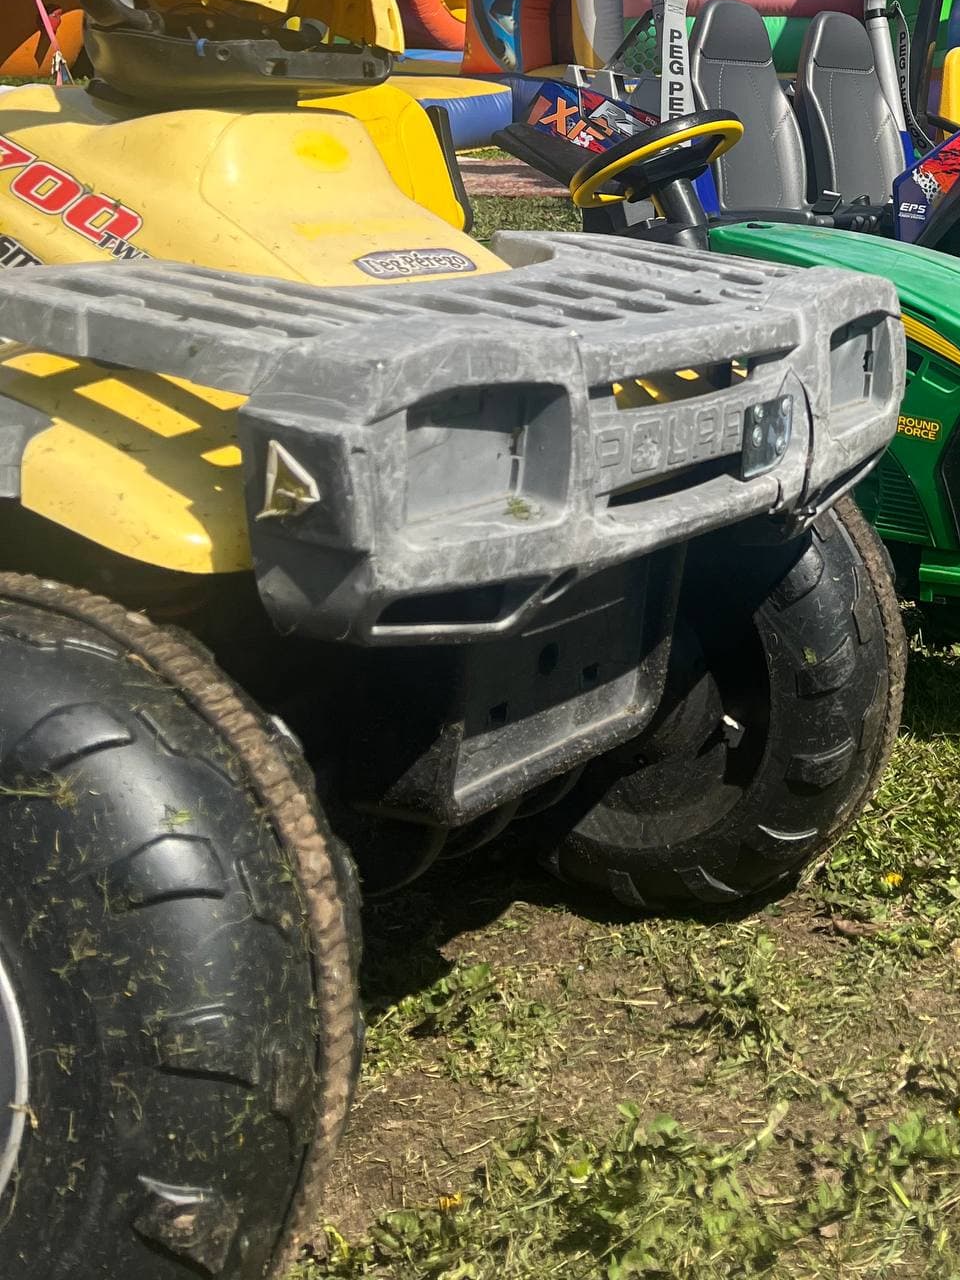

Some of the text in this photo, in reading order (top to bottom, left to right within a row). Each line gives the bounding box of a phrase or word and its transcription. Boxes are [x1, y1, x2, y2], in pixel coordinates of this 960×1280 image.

[669, 29, 684, 76] PEG
[899, 202, 927, 214] EPS
[897, 424, 937, 440] FORCE
